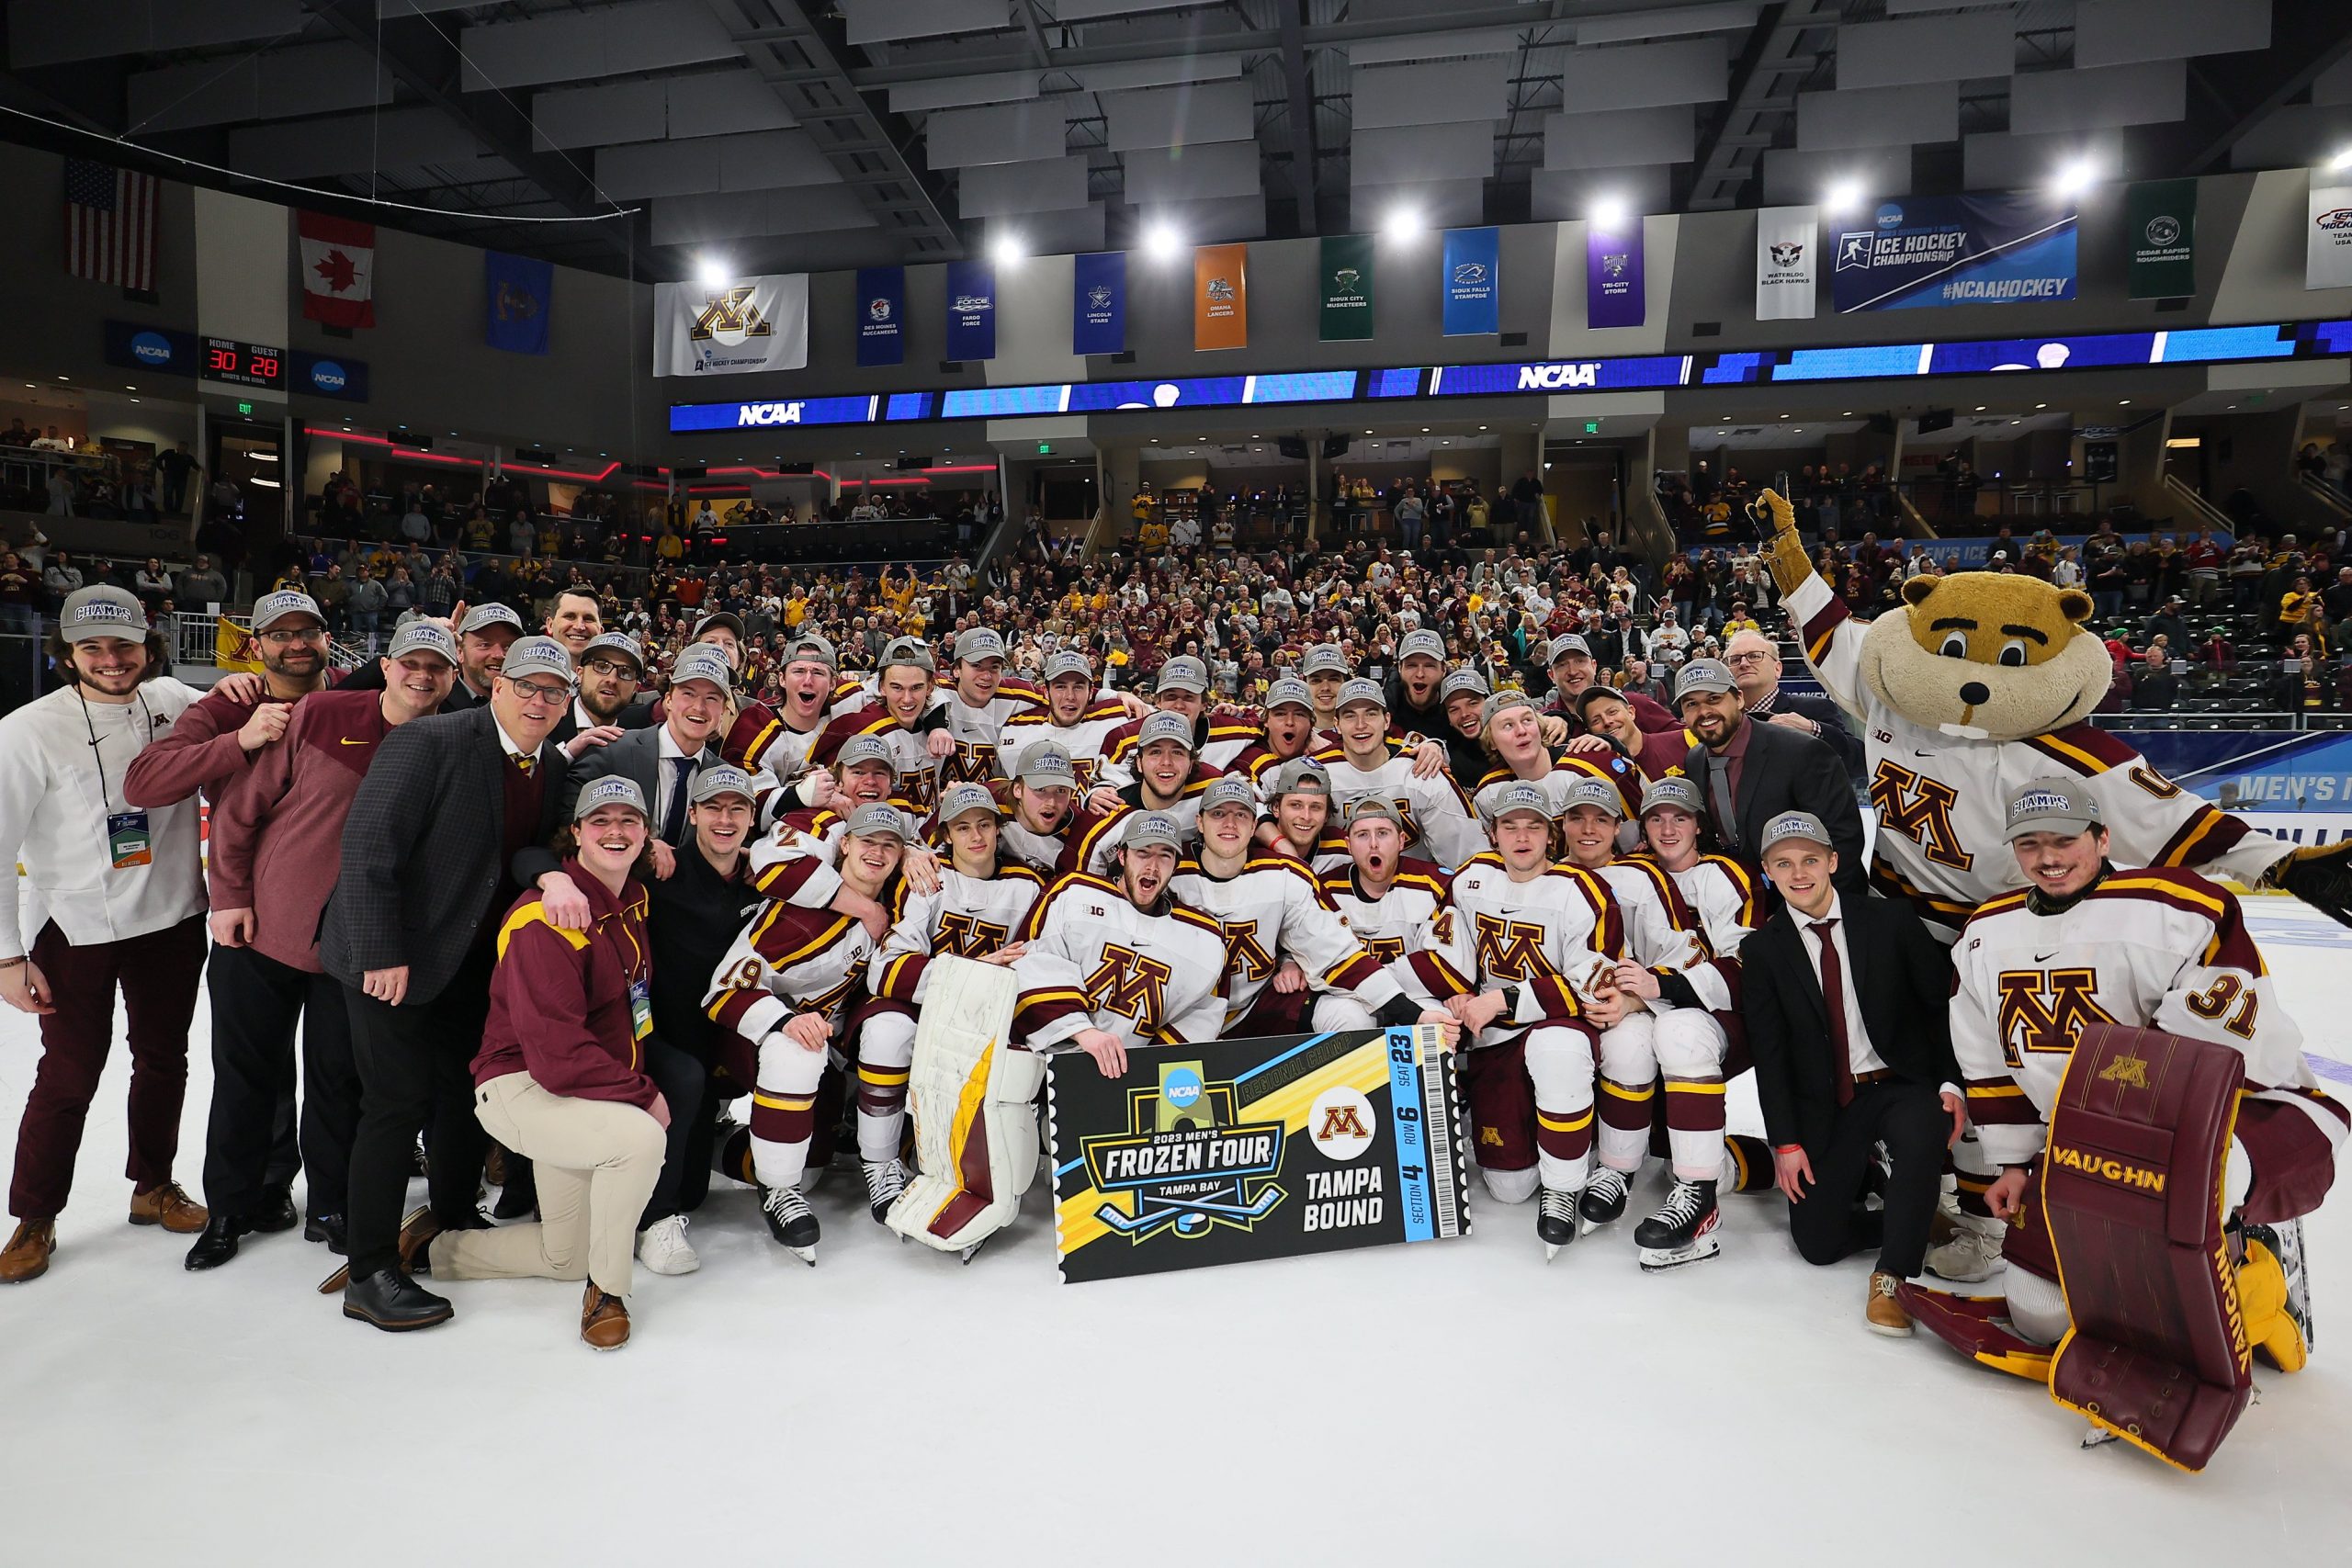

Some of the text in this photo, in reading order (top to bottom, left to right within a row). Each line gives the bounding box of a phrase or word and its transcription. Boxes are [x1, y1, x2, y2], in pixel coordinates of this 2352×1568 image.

[1878, 215, 1903, 223] NCAA
[1875, 232, 1967, 254] ICE HOCKEY
[1873, 250, 1954, 266] CHAMPIONSHIP
[1942, 277, 2068, 300] #NCAAHOCKEY
[135, 345, 170, 358] NCAA
[209, 339, 235, 350] HOME
[251, 346, 277, 356] GUEST
[209, 350, 236, 370] 30
[251, 356, 277, 377] 28
[730, 357, 768, 366] CHAMPIONSHIP
[221, 373, 240, 381] SHOTS
[314, 373, 345, 385] NCAA
[1518, 366, 1597, 389] NCAA
[239, 404, 252, 413] EXIT
[738, 401, 802, 426] NCAA
[1586, 423, 1598, 433] EXIT
[149, 529, 179, 540] 106
[1964, 546, 1987, 559] ICE
[75, 604, 132, 622] CHAMPS
[266, 597, 313, 614] CHAMPS
[403, 631, 448, 650] CHAMPS
[1164, 667, 1196, 680] CHAMPS
[1680, 669, 1716, 684] CHAMPS
[1344, 684, 1376, 696] CHAMPS
[1148, 721, 1186, 736] CHAMPS
[853, 740, 888, 758] CHAMPS
[1034, 758, 1069, 772] CHAMPS
[705, 773, 747, 789] CHAMPS
[2238, 776, 2335, 800] MEN'S
[590, 783, 636, 802] CHAMPS
[1213, 784, 1250, 801] CHAMPS
[1504, 791, 1544, 807] CHAMPS
[1572, 787, 1611, 802] CHAMPS
[1649, 786, 1688, 802] CHAMPS
[2012, 795, 2070, 818] CHAMPS
[864, 812, 901, 830] CHAMPS
[1138, 821, 1177, 840] CHAMPS
[1770, 820, 1815, 840] CHAMPS
[718, 956, 762, 990] 19
[1085, 942, 1172, 1038] M
[2186, 974, 2258, 1040] 31
[1242, 1033, 1351, 1102] REGIONAL CHAMP
[1168, 1086, 1200, 1098] NCAA
[1390, 1033, 1425, 1224] SECTION 4 ROW 6 SEAT 23
[1153, 1130, 1218, 1145] 2023 MEN'S
[1104, 1135, 1272, 1179] FROZEN FOUR
[2052, 1145, 2166, 1192] VAUGHN
[1159, 1181, 1221, 1197] TAMPA BAY
[1306, 1166, 1383, 1201] TAMPA
[1304, 1197, 1384, 1233] BOUND
[2214, 1243, 2249, 1375] VAUGHN
